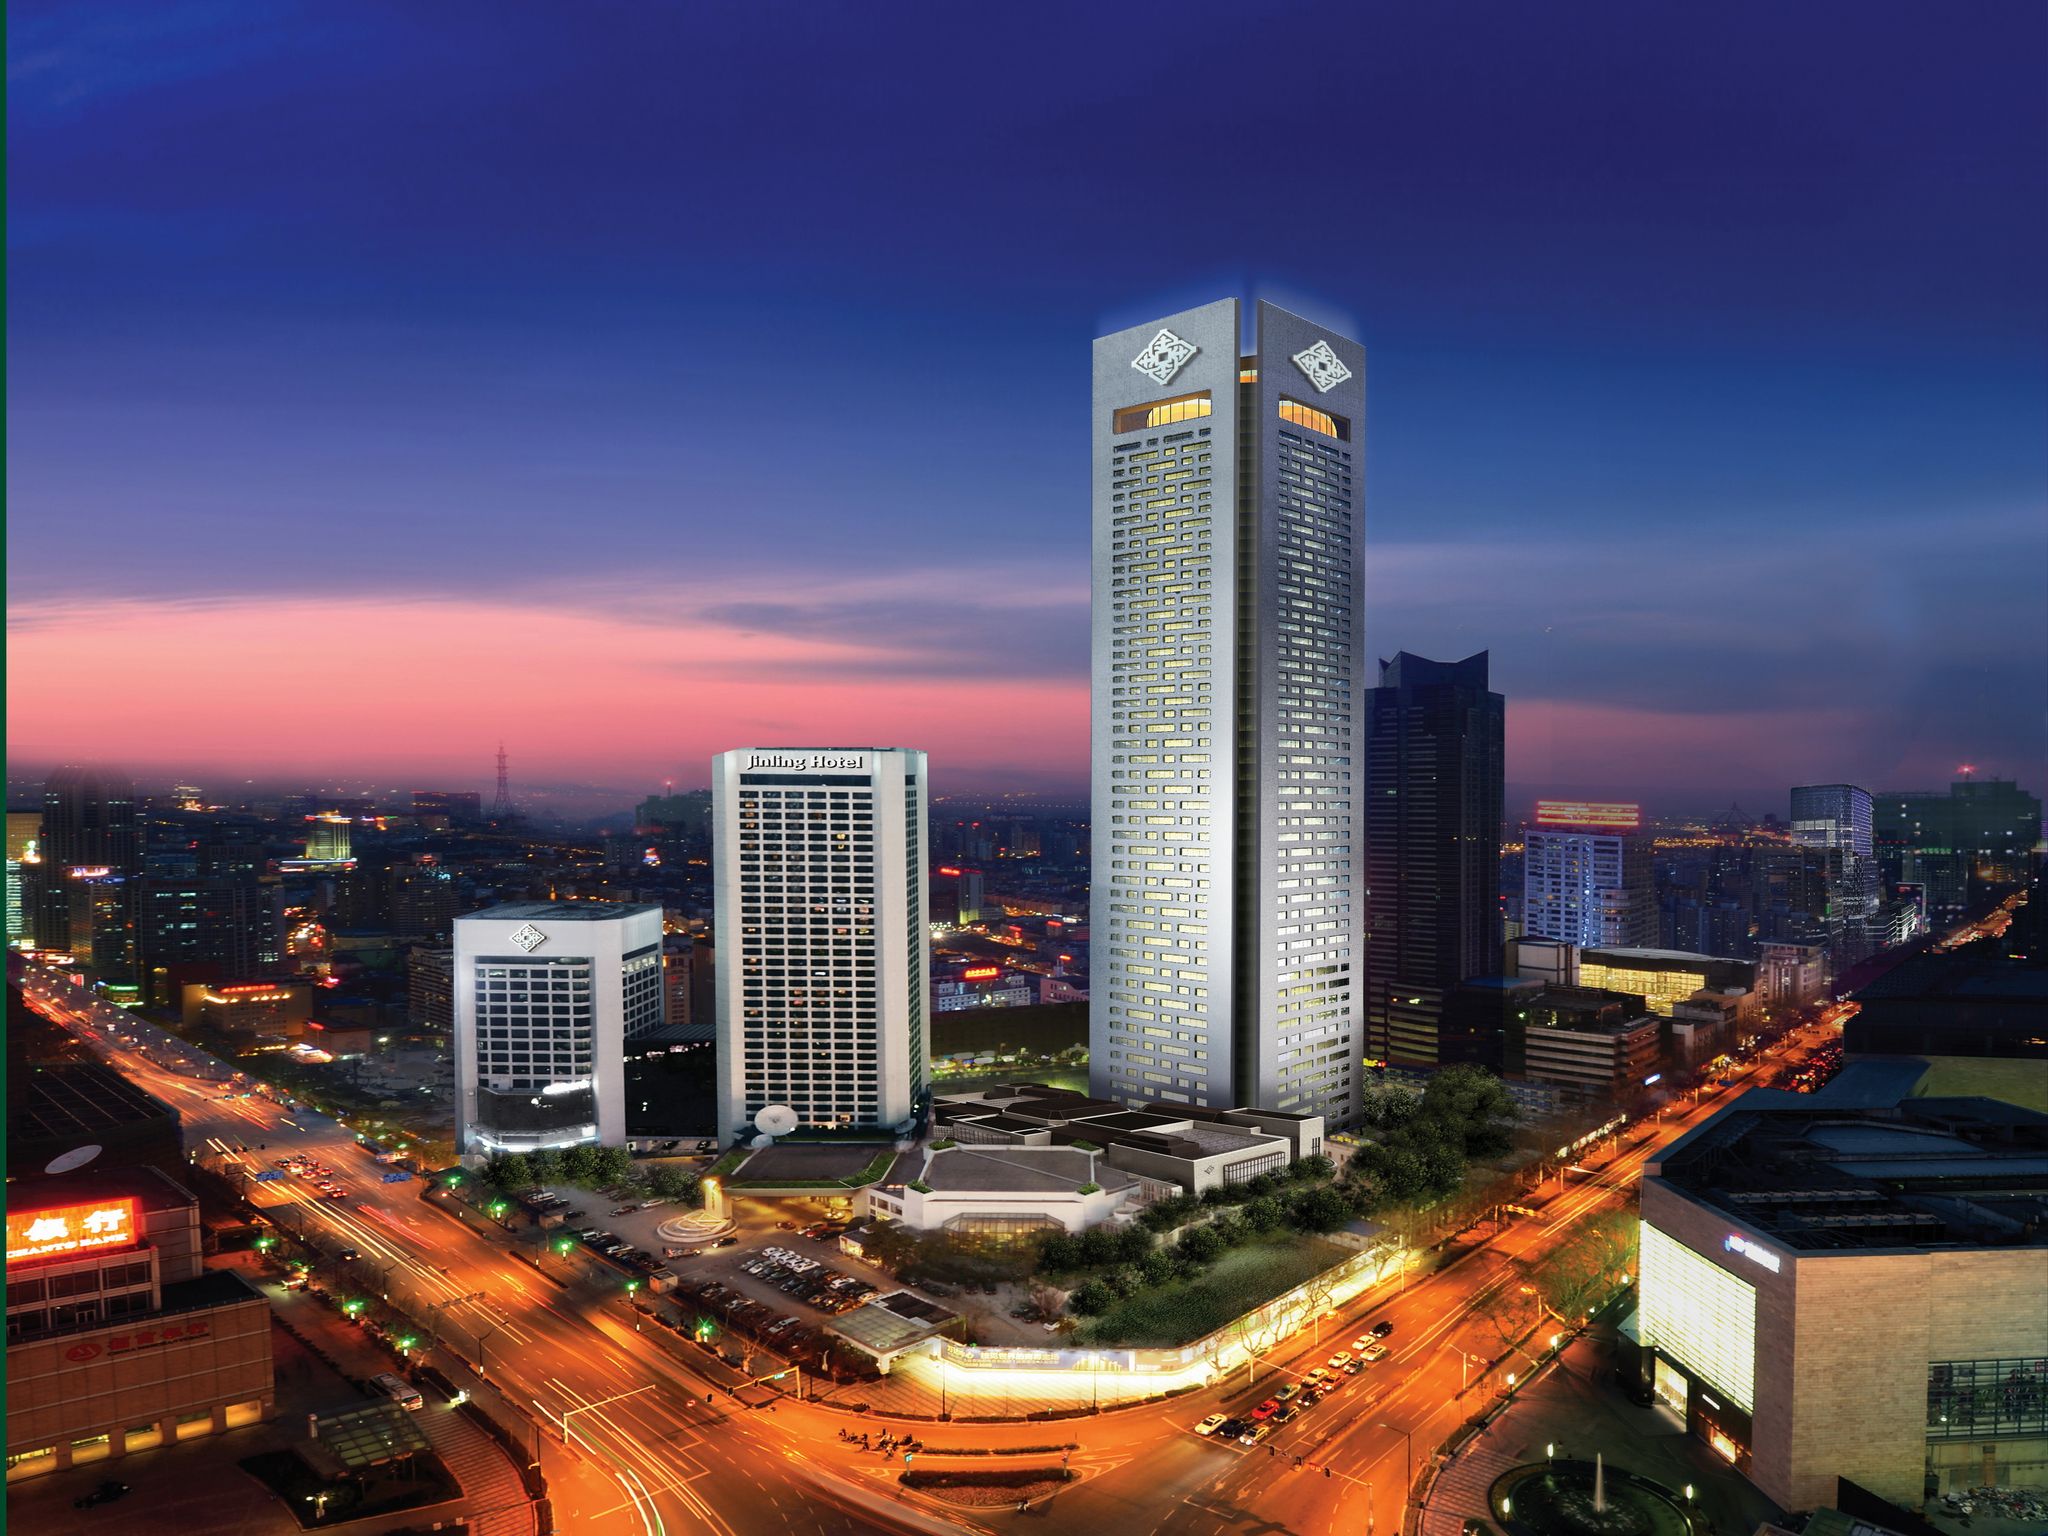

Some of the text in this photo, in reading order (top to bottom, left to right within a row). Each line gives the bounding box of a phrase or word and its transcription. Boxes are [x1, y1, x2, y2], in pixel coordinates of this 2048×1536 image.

[748, 755, 863, 771] Jinling Hotel
[79, 1233, 128, 1247] BANK
